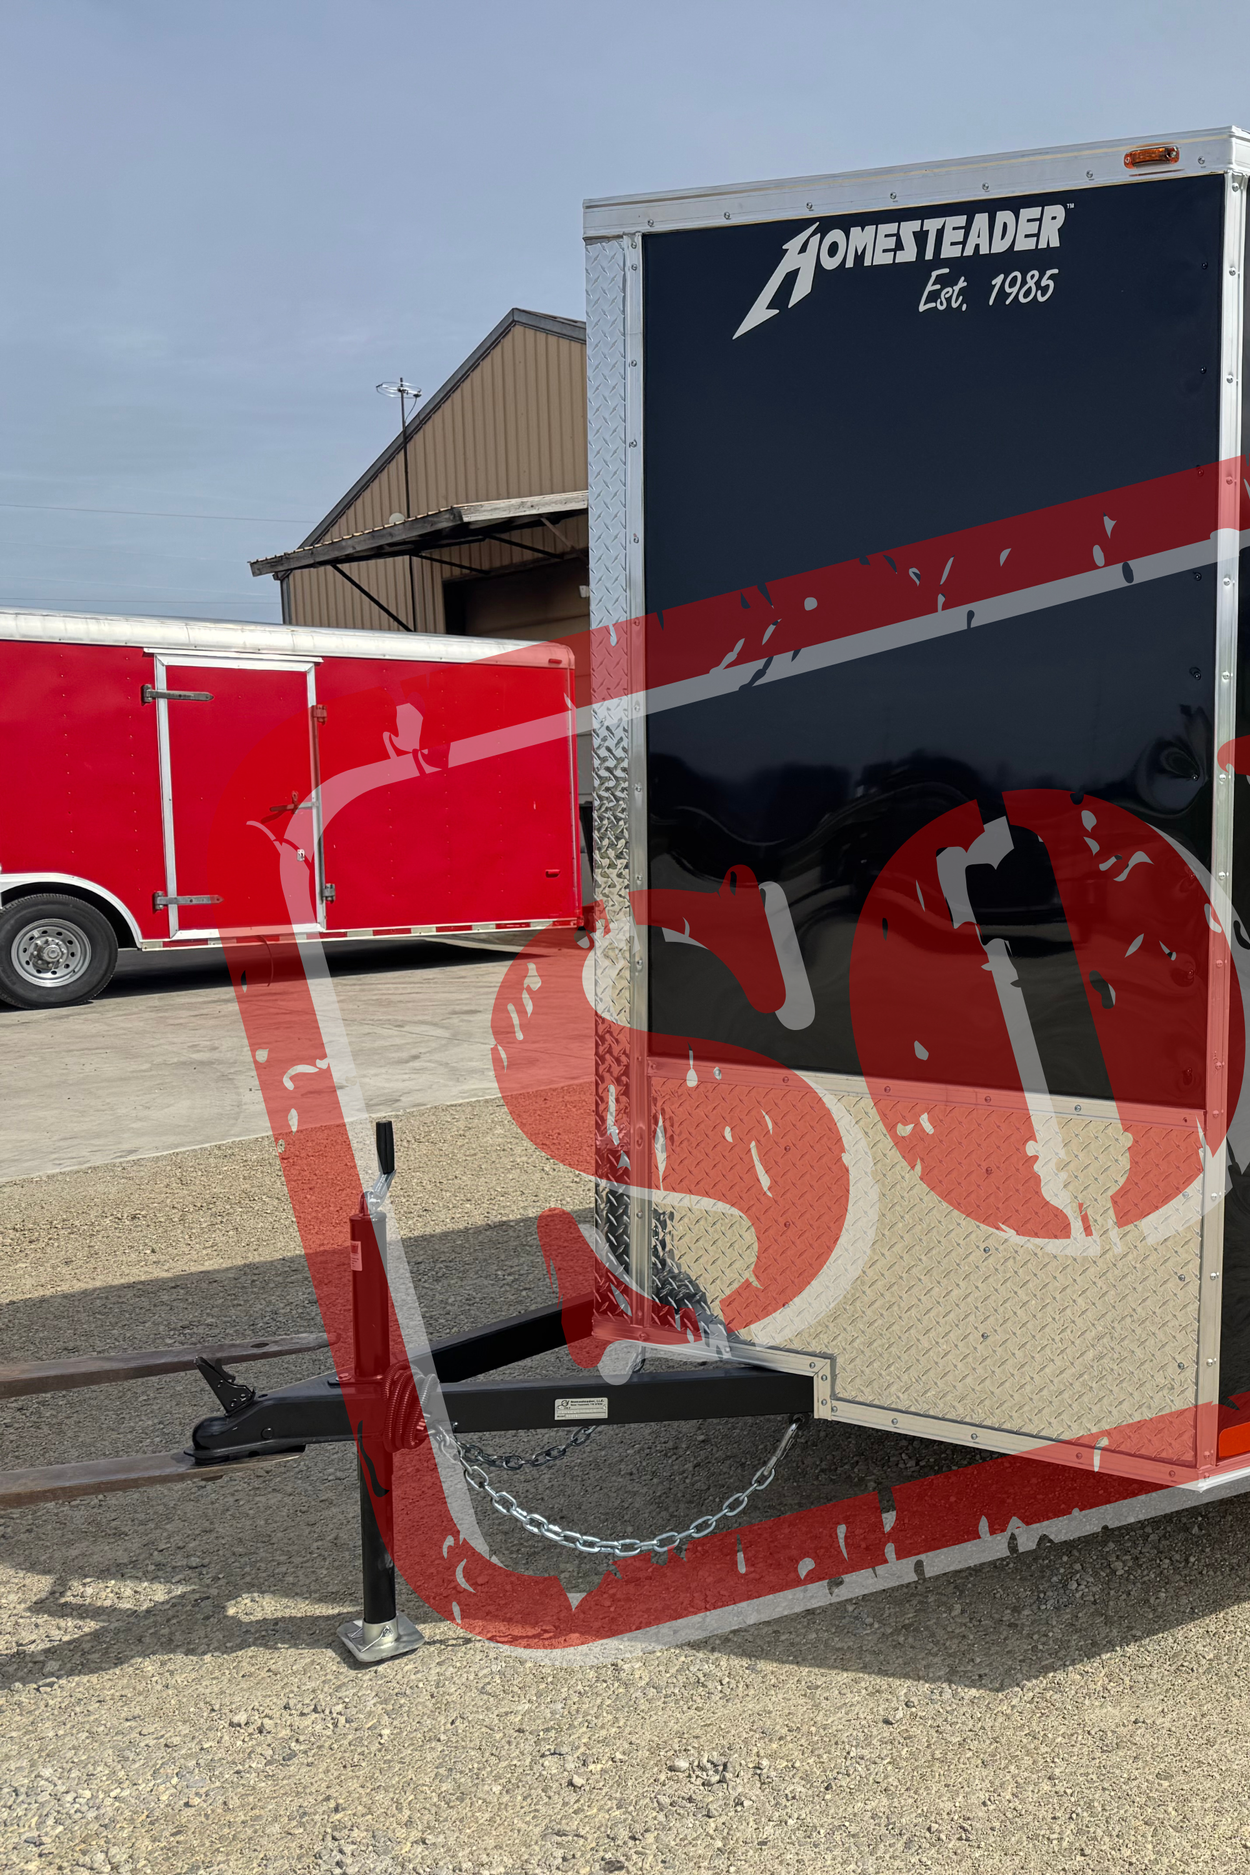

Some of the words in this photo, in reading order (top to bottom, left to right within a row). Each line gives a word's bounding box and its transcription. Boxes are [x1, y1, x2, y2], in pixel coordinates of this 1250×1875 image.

[733, 204, 1066, 340] HOMESTEADER
[918, 267, 968, 312] Est.
[988, 268, 1059, 306] 1985
